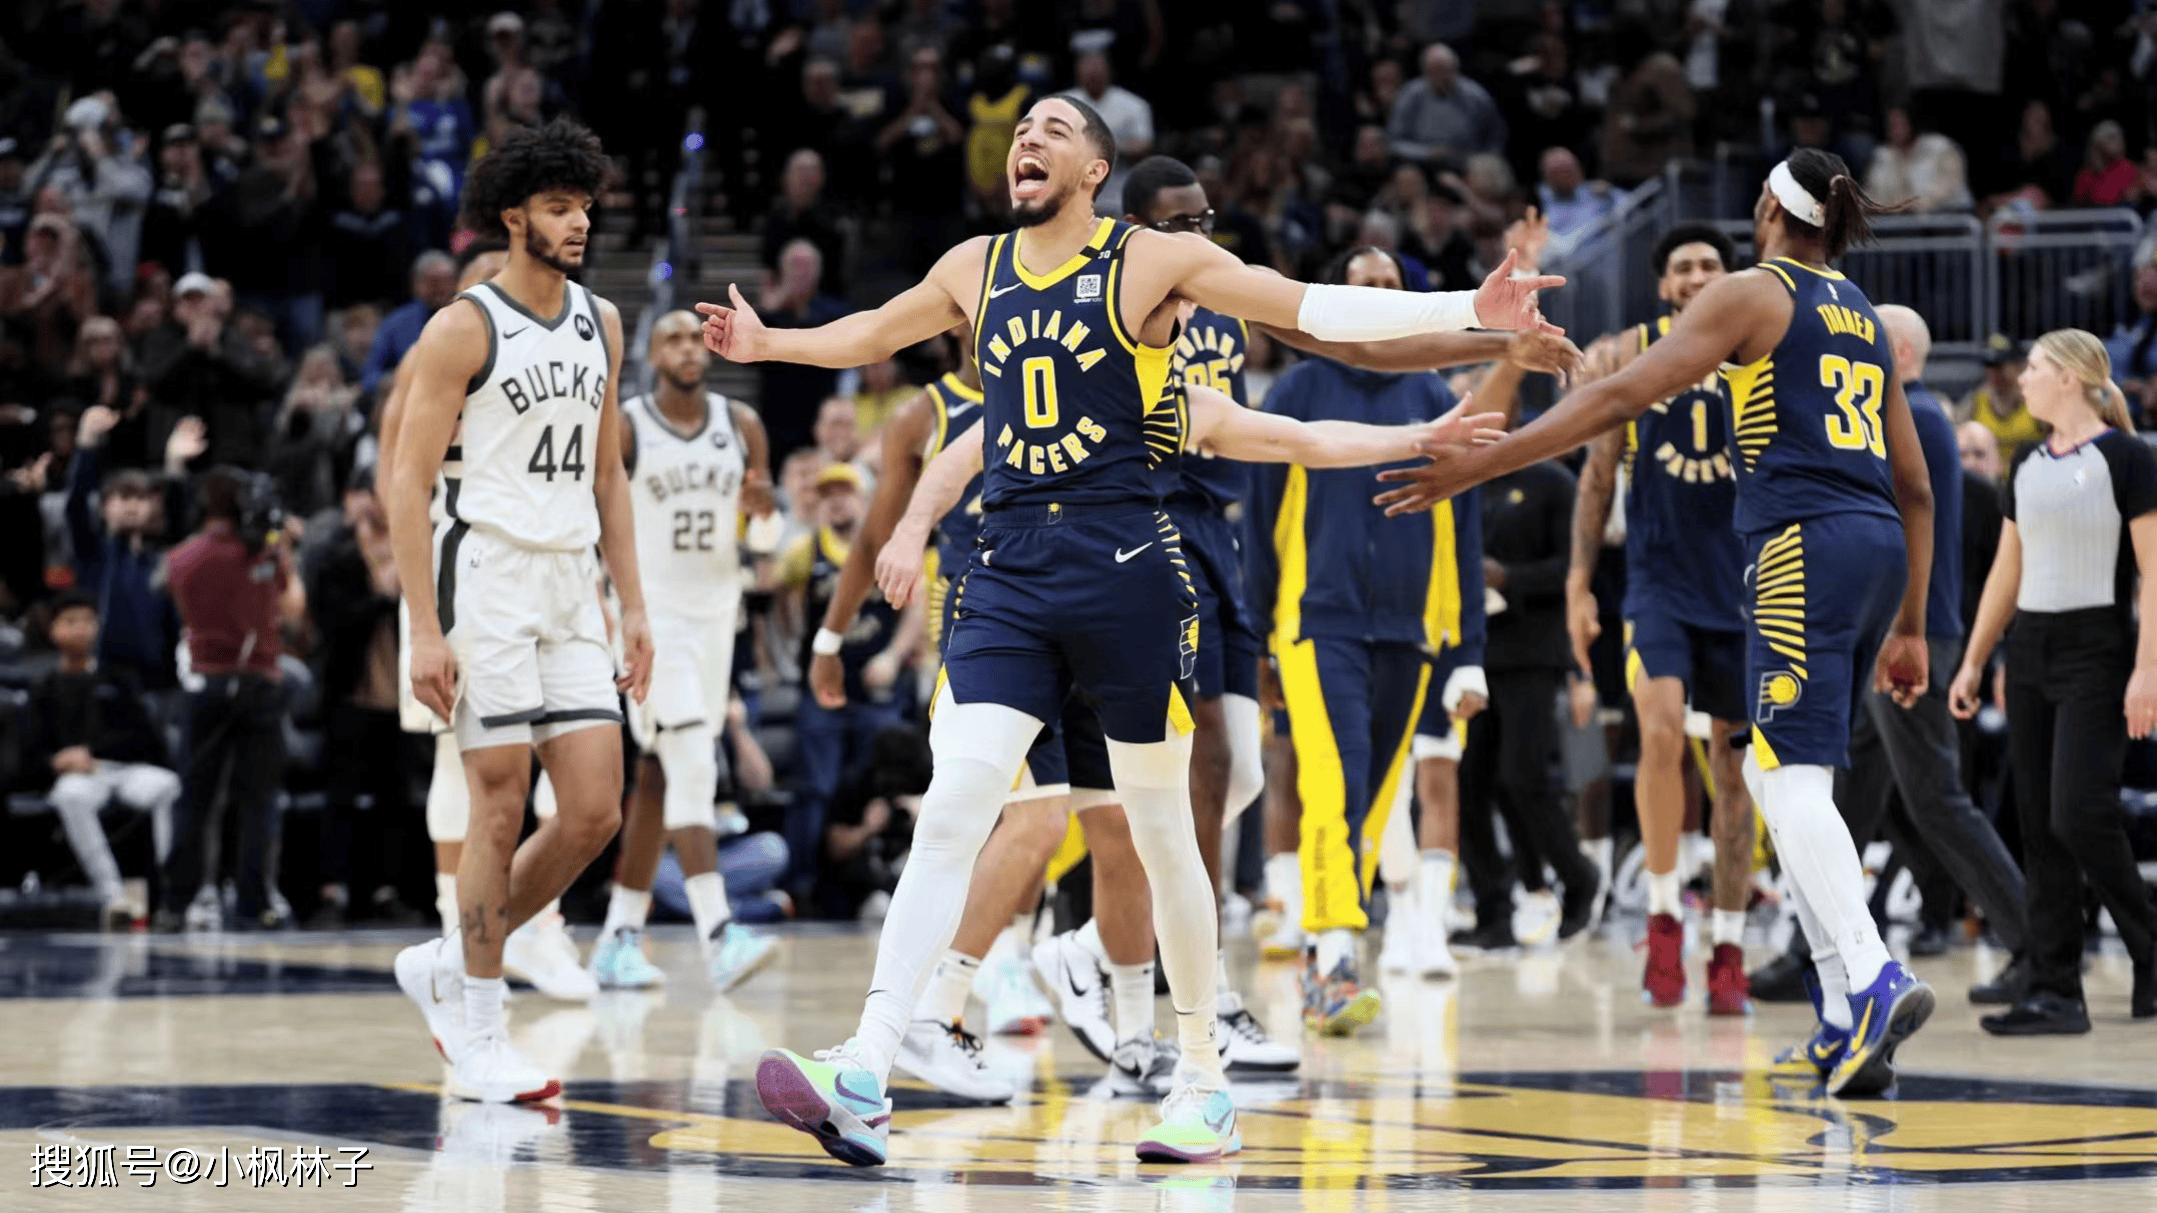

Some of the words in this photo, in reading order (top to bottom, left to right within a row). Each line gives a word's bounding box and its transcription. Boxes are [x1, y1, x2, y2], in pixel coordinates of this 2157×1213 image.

[984, 309, 1107, 377] INDIANA
[1816, 304, 1875, 346] TURNER
[501, 361, 608, 415] BUCKS
[1022, 355, 1060, 429] 0
[1819, 354, 1887, 460] 33
[528, 424, 585, 482] 44
[997, 416, 1107, 475] PACERS
[1690, 399, 1708, 453] 1
[646, 463, 735, 503] BUCKS
[673, 510, 715, 551] 22
